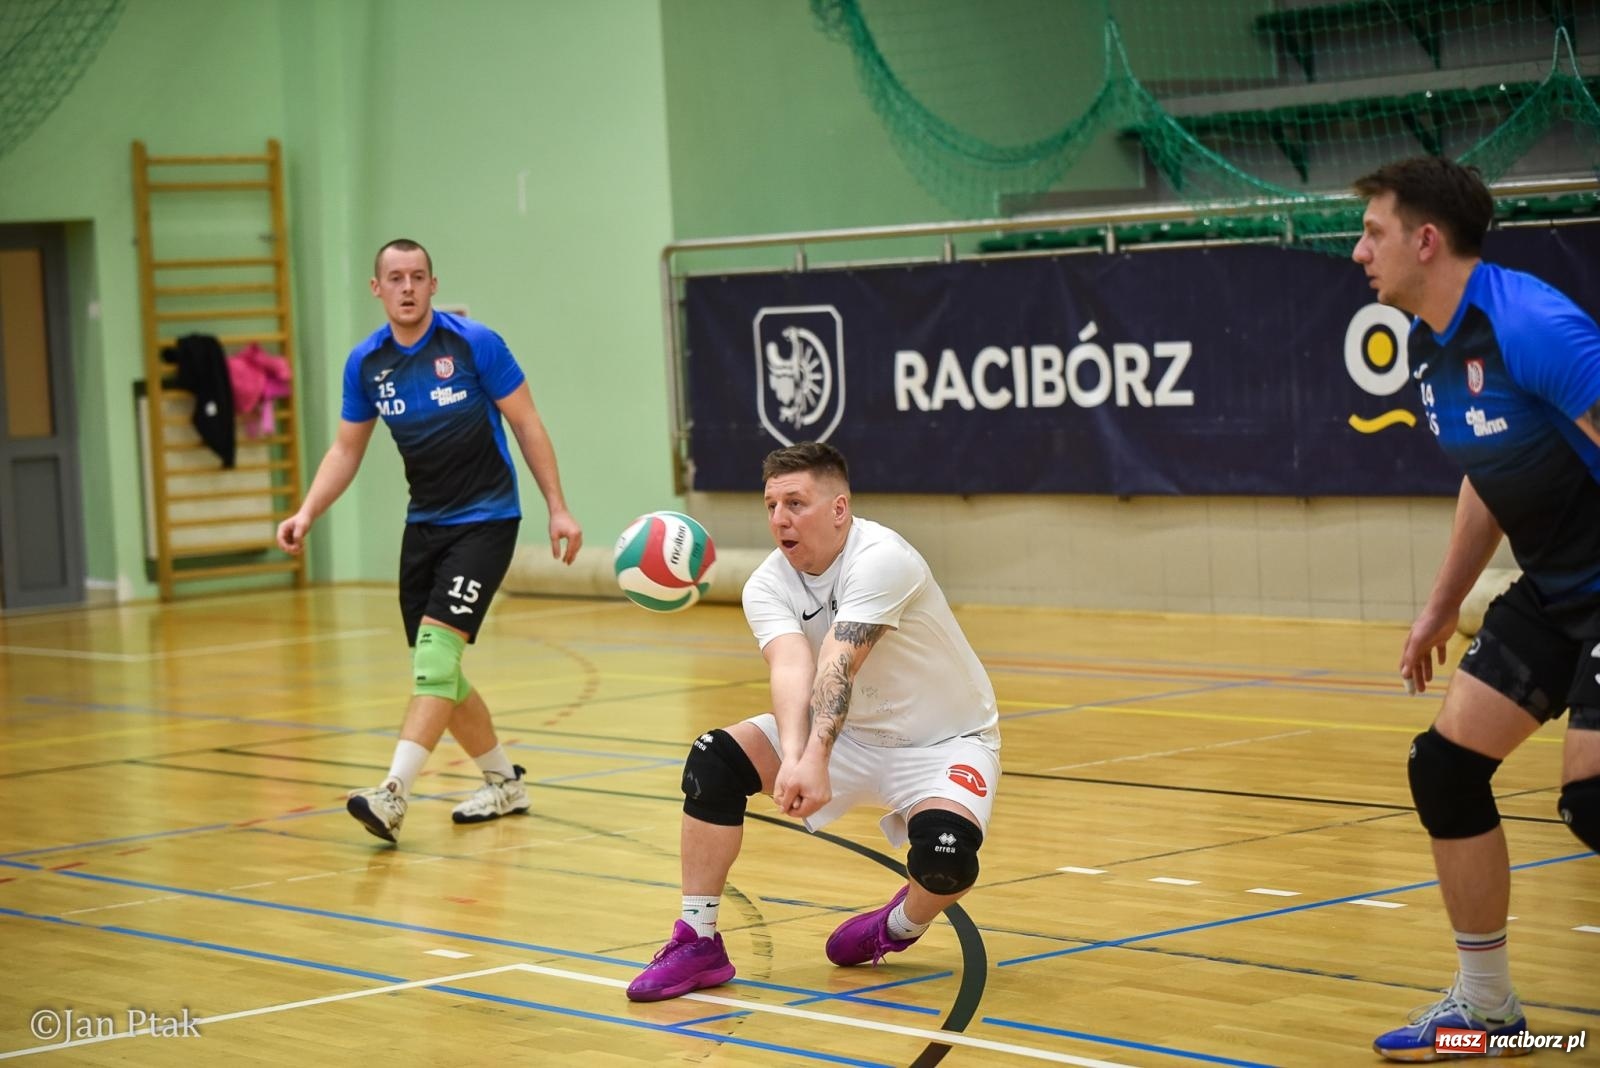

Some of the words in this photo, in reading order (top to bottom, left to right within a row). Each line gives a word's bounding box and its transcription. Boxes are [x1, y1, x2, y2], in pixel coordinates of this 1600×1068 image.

[895, 320, 1194, 411] RACIBÓRZ
[378, 381, 396, 399] 15
[375, 398, 406, 416] M.D
[448, 575, 481, 604] 15
